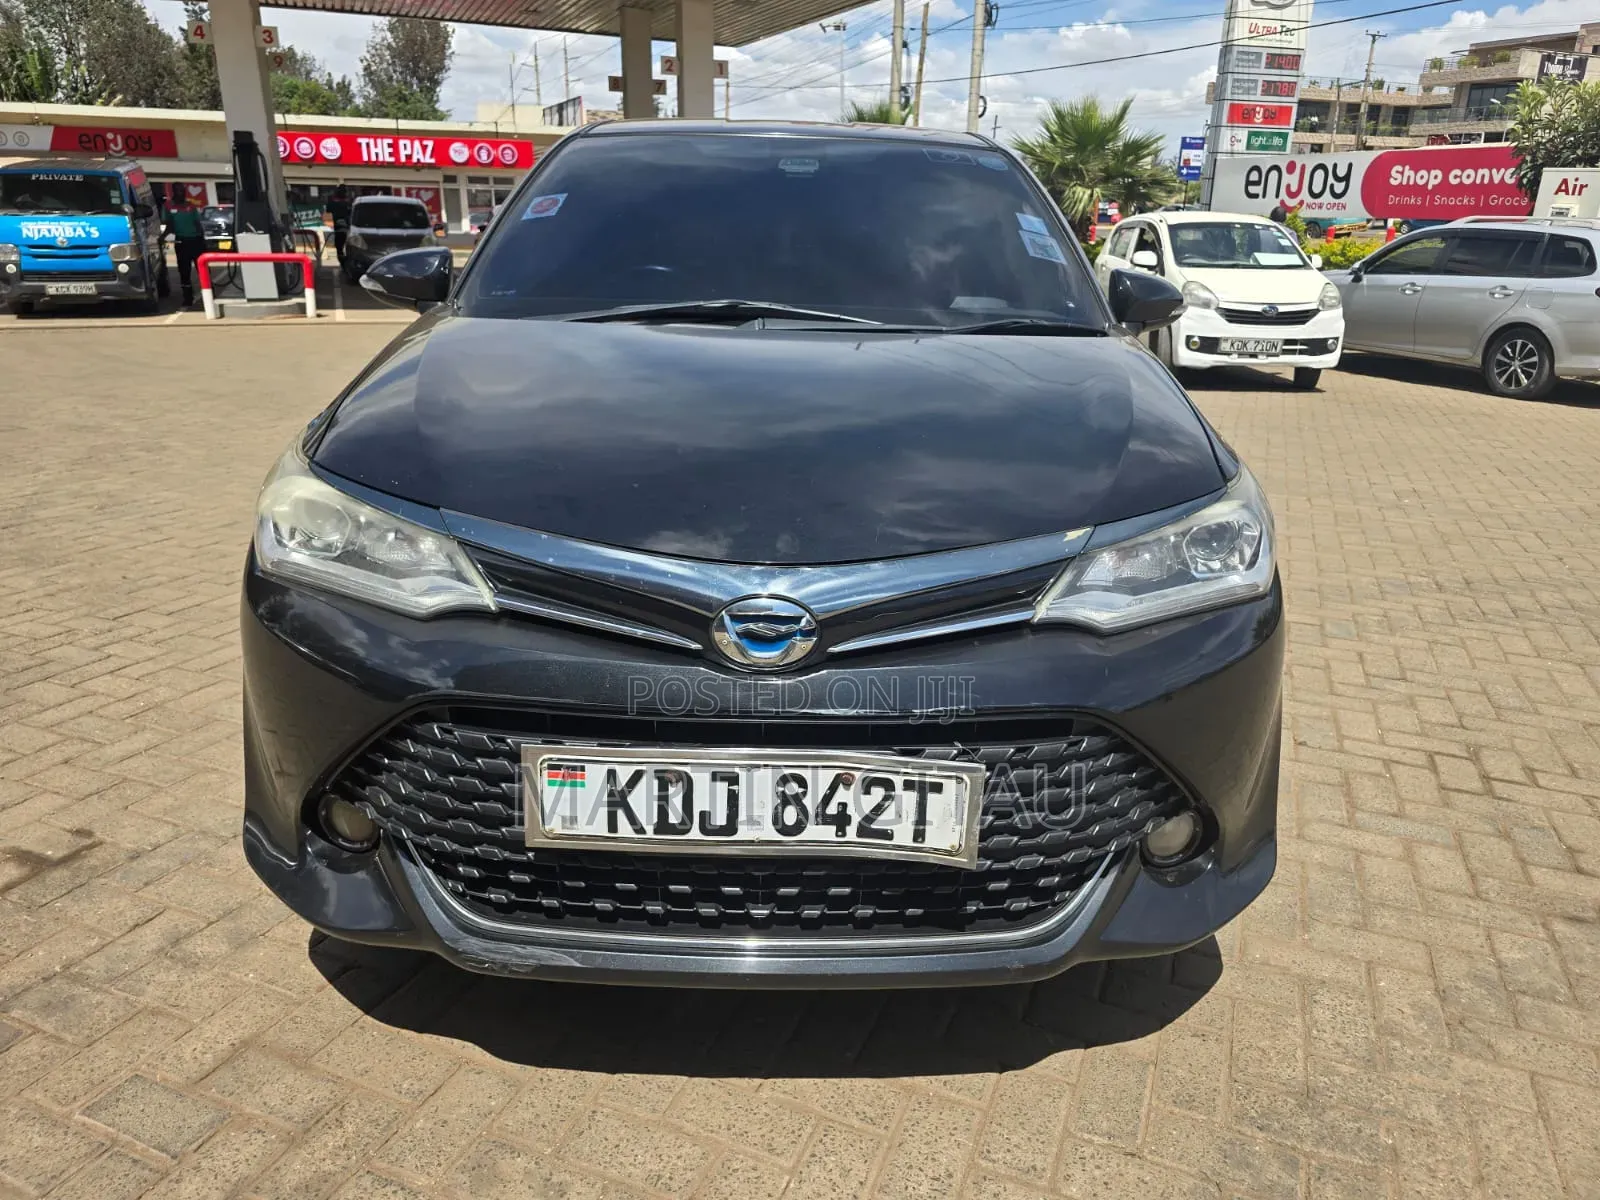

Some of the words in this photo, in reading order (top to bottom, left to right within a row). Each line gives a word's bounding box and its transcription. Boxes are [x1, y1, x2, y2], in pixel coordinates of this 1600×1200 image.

[193, 24, 206, 39] 4
[262, 29, 274, 44] 3
[664, 59, 674, 72] 2
[717, 62, 724, 75] 1
[655, 82, 664, 93] 7
[357, 137, 395, 162] THE
[398, 139, 435, 164] PAZ
[31, 174, 84, 182] PRIVATE
[1244, 160, 1353, 201] enjoy
[1389, 164, 1442, 190] Shop
[1553, 177, 1589, 196] Air
[1306, 202, 1324, 211] NOW
[1326, 202, 1347, 211] OPEN
[1388, 194, 1422, 206] Drinks
[1434, 194, 1475, 207] Snacks
[21, 225, 100, 240] NJAMBA'S
[1229, 339, 1248, 352] KDK
[606, 768, 740, 837] KDJ
[771, 771, 944, 844] 842T
